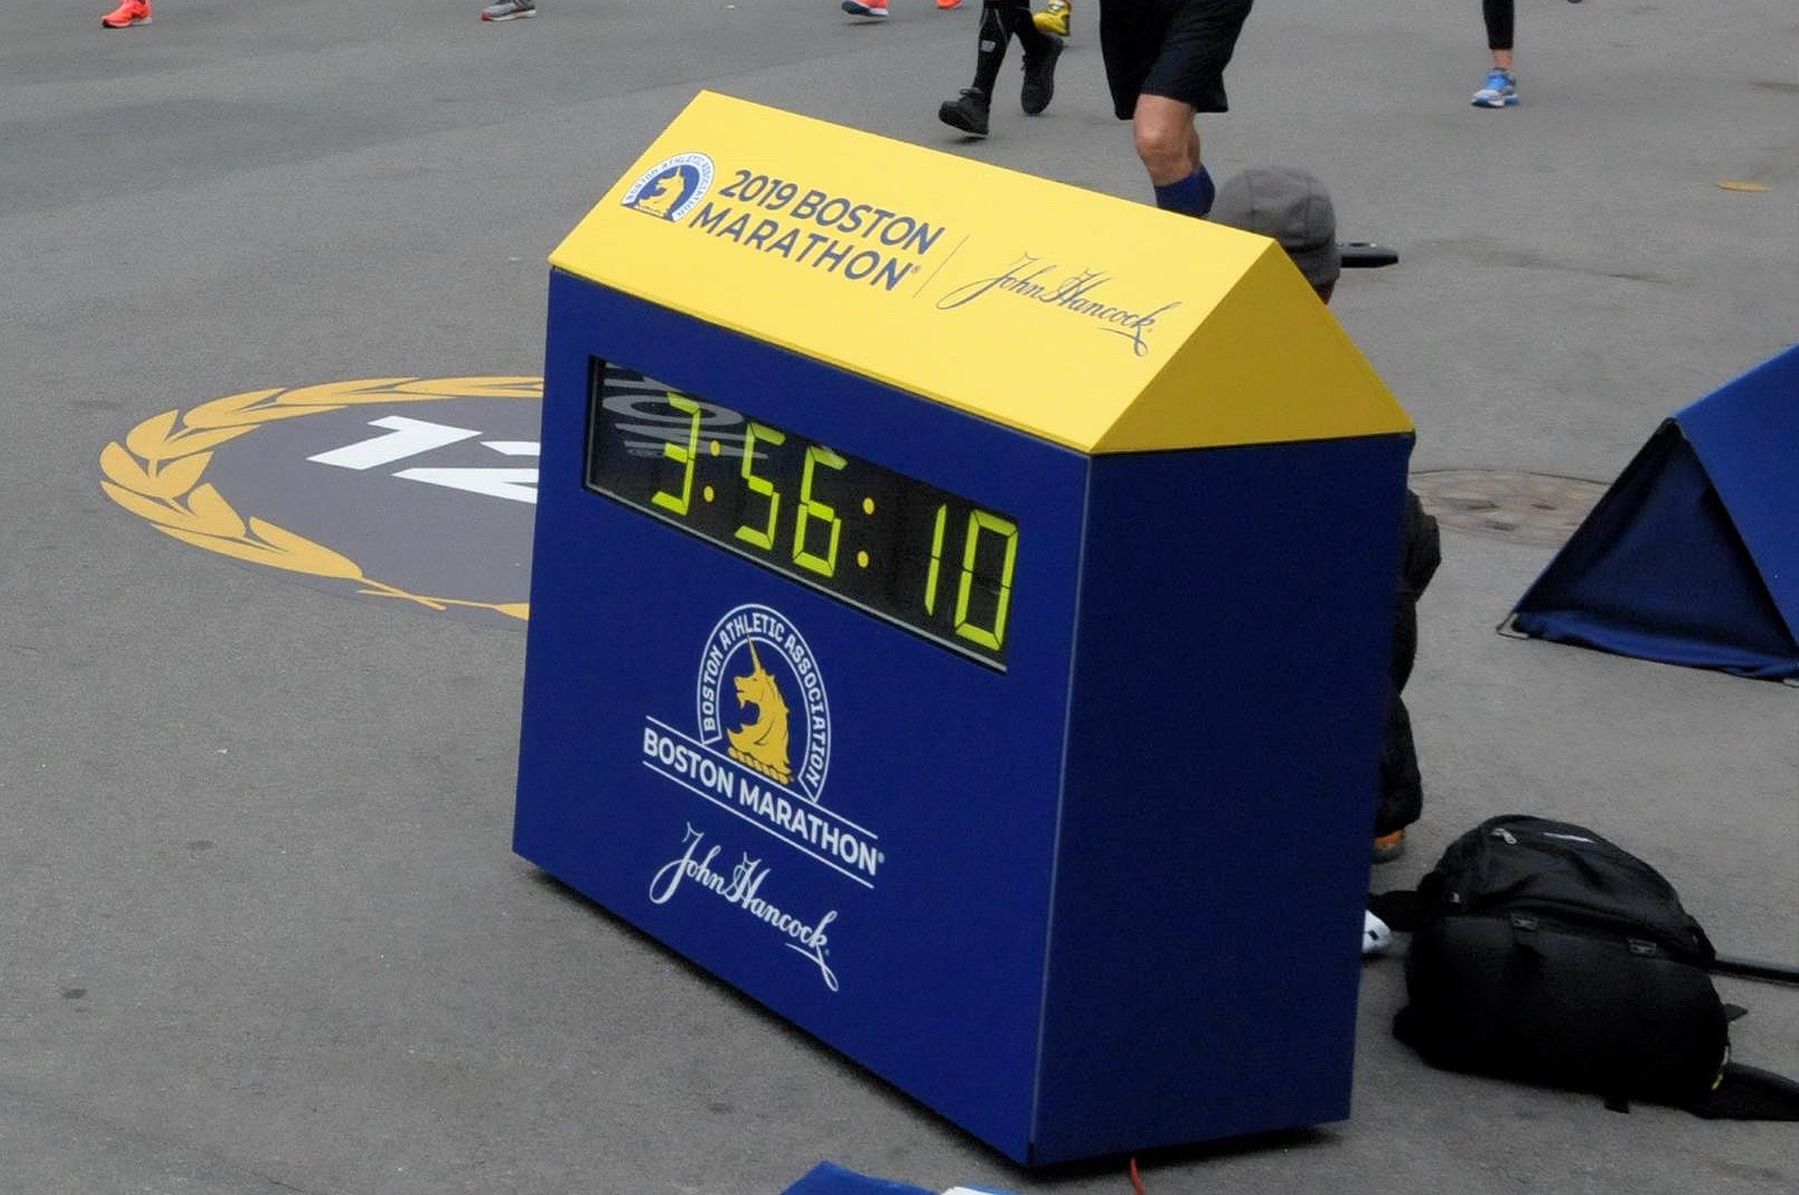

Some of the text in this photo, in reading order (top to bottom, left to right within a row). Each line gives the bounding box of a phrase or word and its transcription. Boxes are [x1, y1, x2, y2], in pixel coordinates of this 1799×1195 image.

[718, 169, 946, 255] 2019 BOSTON
[936, 251, 1182, 357] John Hancock
[702, 612, 827, 788] BOSTON ATHLETIC ASSOCIATION
[643, 727, 734, 799] BOSTON
[649, 821, 839, 993] John Hancock
